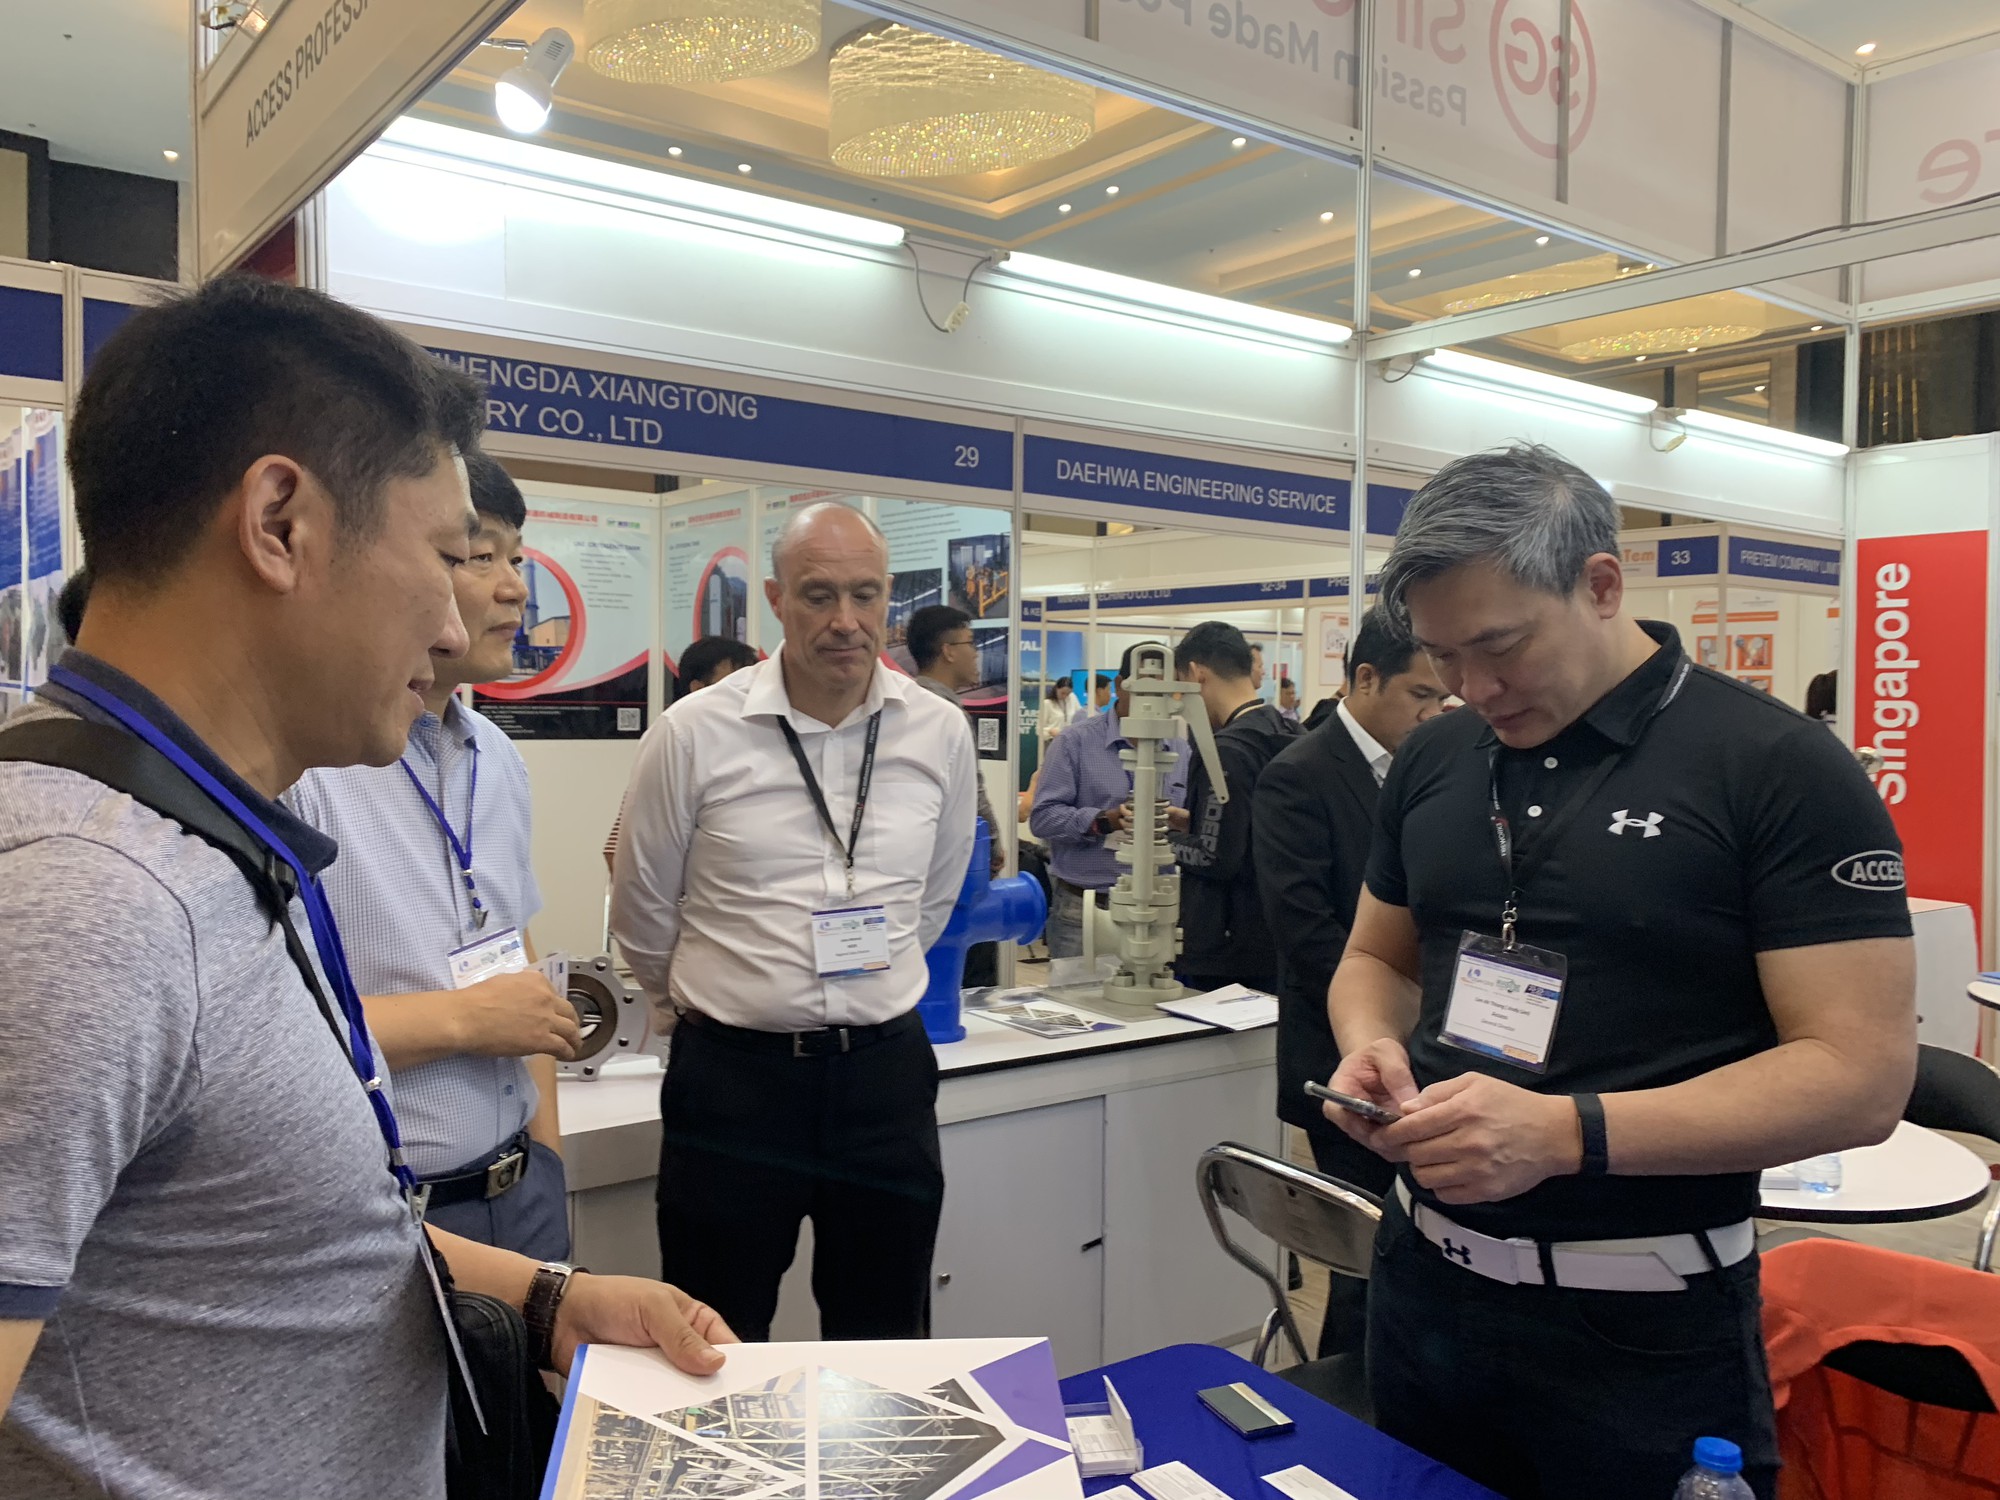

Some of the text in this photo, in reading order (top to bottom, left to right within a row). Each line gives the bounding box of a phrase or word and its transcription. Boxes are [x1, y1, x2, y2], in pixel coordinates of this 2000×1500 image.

[246, 60, 292, 148] ACCESS
[588, 374, 758, 420] XIANGTONG
[610, 414, 663, 445] LTD
[954, 445, 980, 468] 29
[1056, 459, 1337, 515] DAEHWA ENGINEERING SERVICE
[1622, 549, 1656, 562] Tem
[1671, 550, 1691, 565] 33
[1780, 554, 1819, 573] COMPANY
